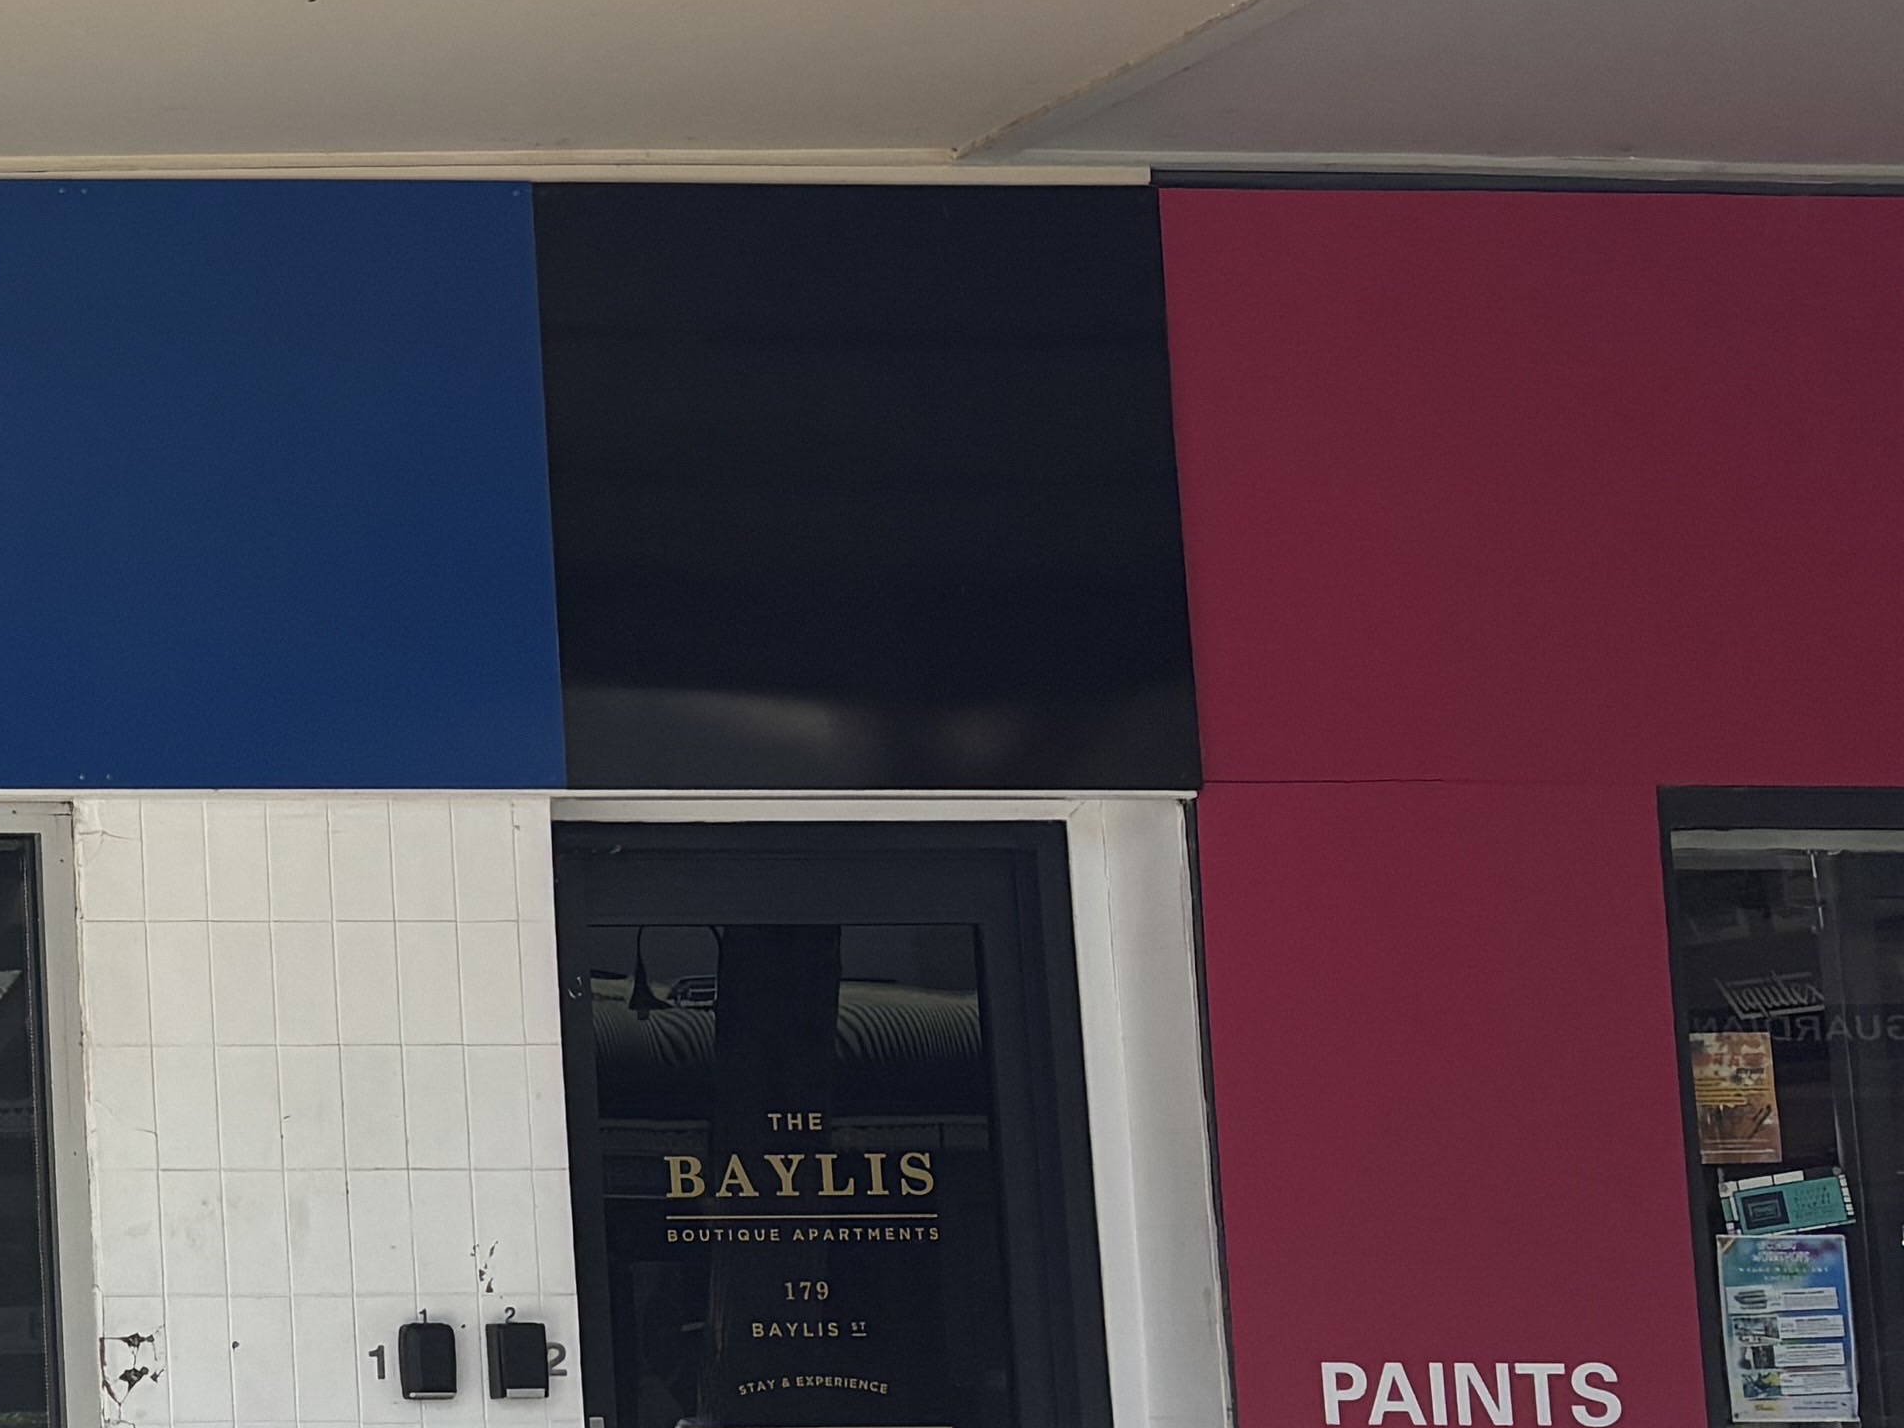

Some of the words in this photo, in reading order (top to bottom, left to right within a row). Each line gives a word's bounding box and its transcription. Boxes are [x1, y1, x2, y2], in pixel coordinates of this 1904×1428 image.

[768, 1113, 823, 1131] THE
[664, 1151, 936, 1199] BAYLIS
[667, 1228, 781, 1243] BOUTIQUE
[793, 1227, 940, 1242] APARTMENTS
[784, 1281, 830, 1300] 179
[418, 1308, 428, 1323] 1
[504, 1306, 516, 1323] 2
[751, 1322, 840, 1338] BAYLIS
[850, 1321, 867, 1332] ST
[368, 1344, 386, 1380] 1
[548, 1341, 568, 1377] 2
[738, 1379, 776, 1395] STAY
[796, 1376, 889, 1395] EXPERIENCE
[1320, 1361, 1623, 1428] PAINTS
